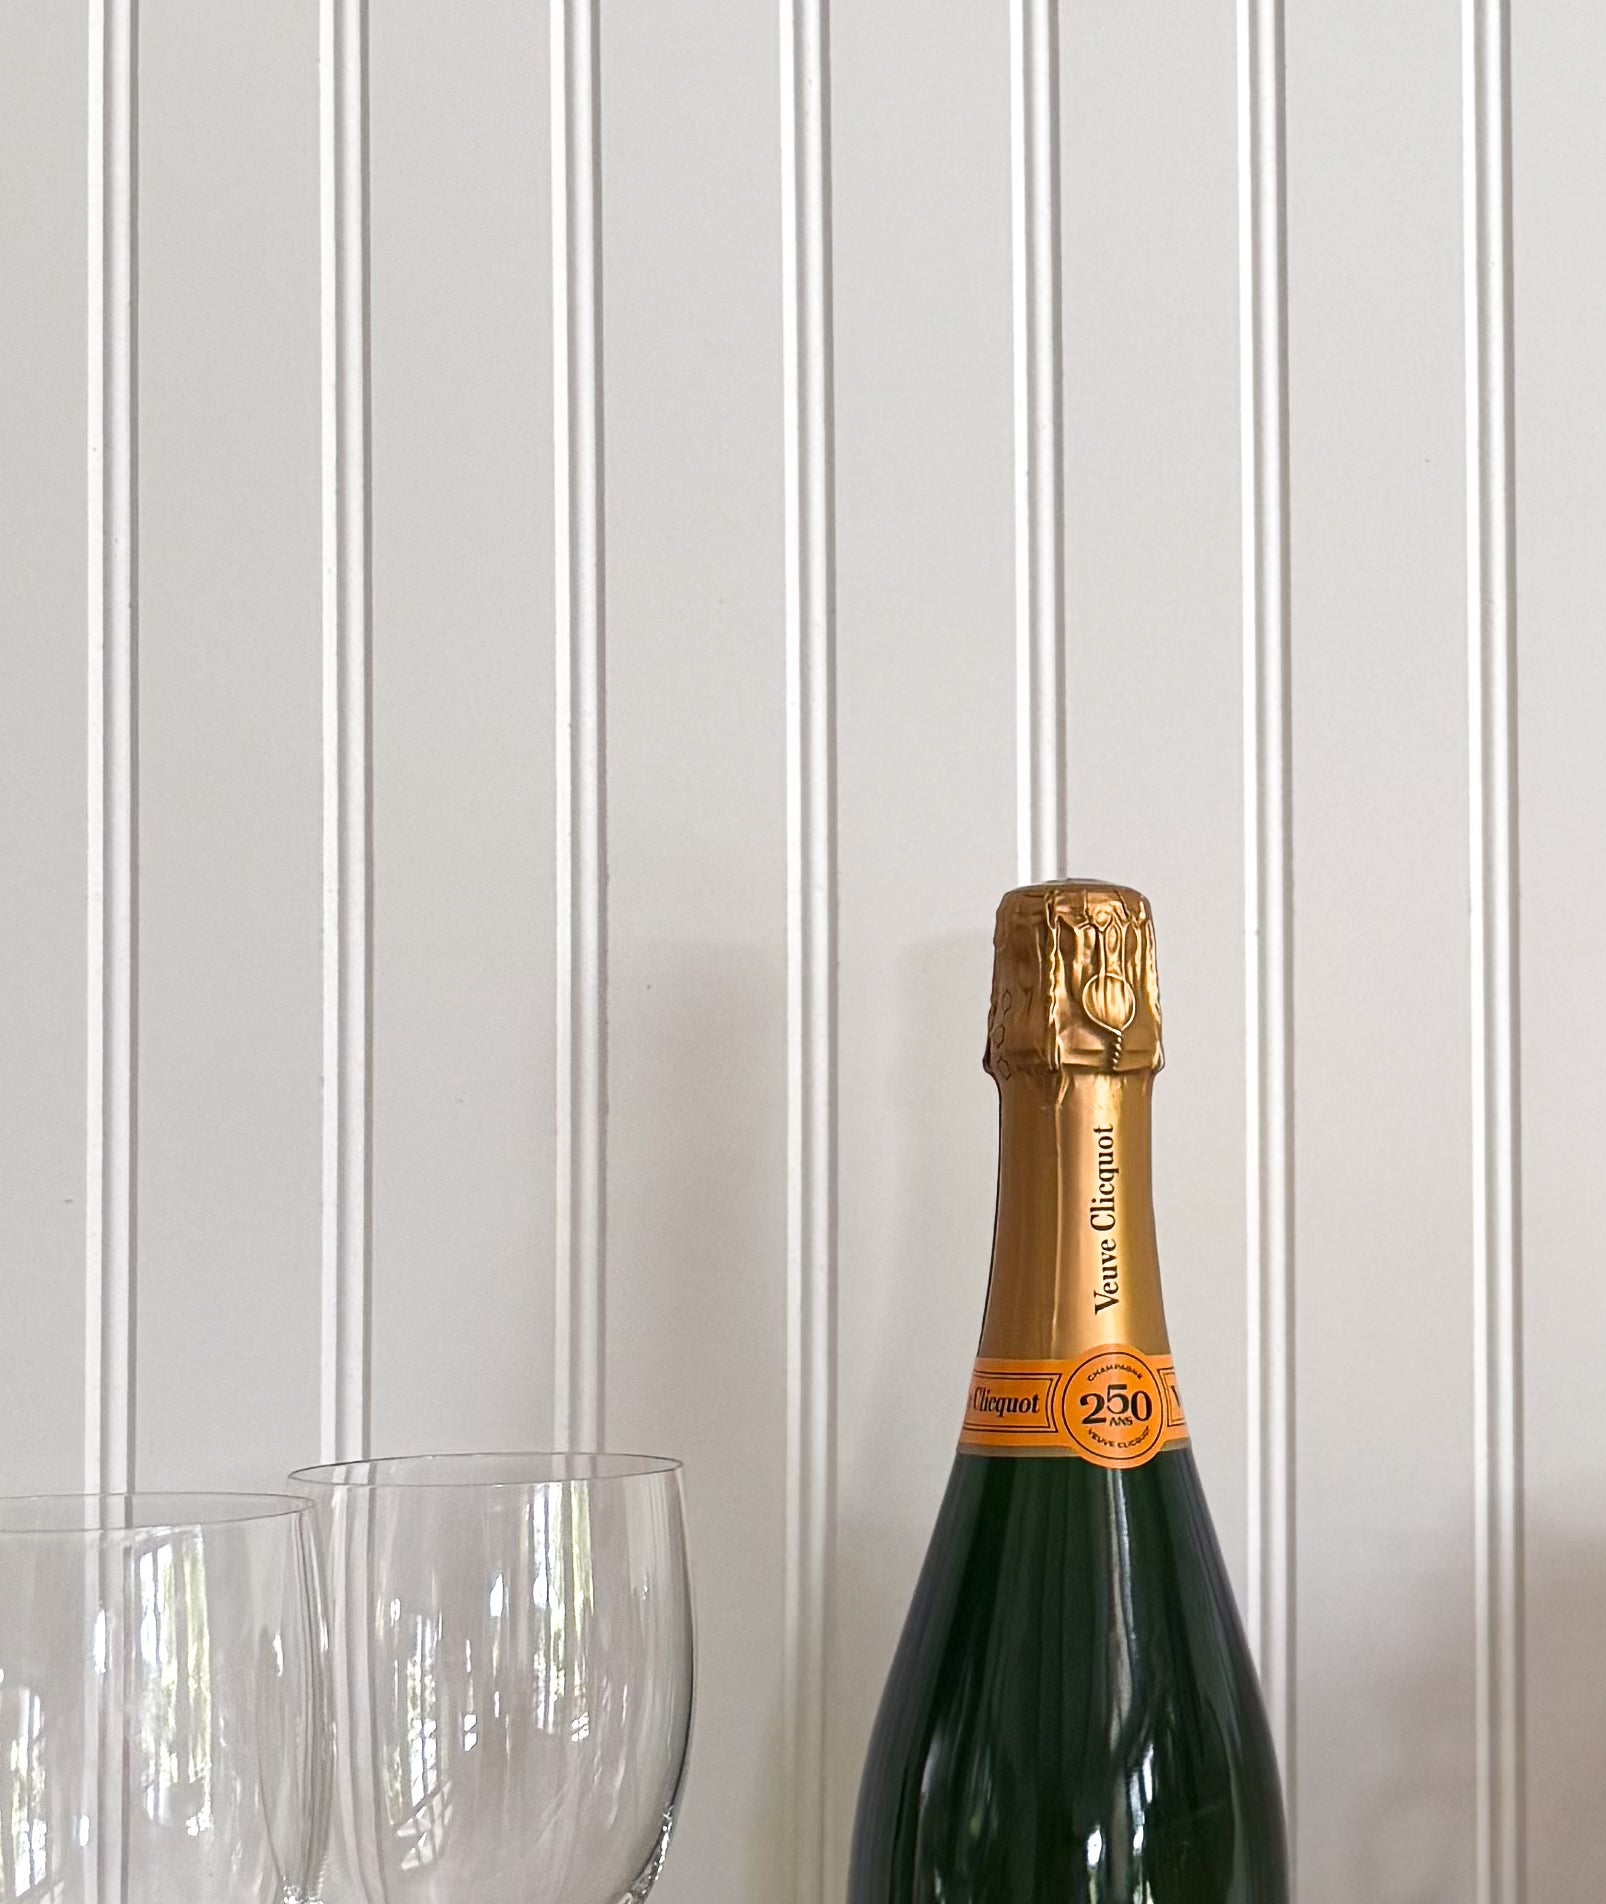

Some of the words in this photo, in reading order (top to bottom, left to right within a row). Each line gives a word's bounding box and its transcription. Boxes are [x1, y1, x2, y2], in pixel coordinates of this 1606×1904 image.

[1089, 1123, 1120, 1232] Clicquot
[1093, 1238, 1119, 1315] Veuve
[1087, 1364, 1144, 1382] CHAMPAGNE
[973, 1386, 1041, 1417] Clicquot
[1079, 1383, 1152, 1425] 250
[1109, 1416, 1134, 1427] ANS
